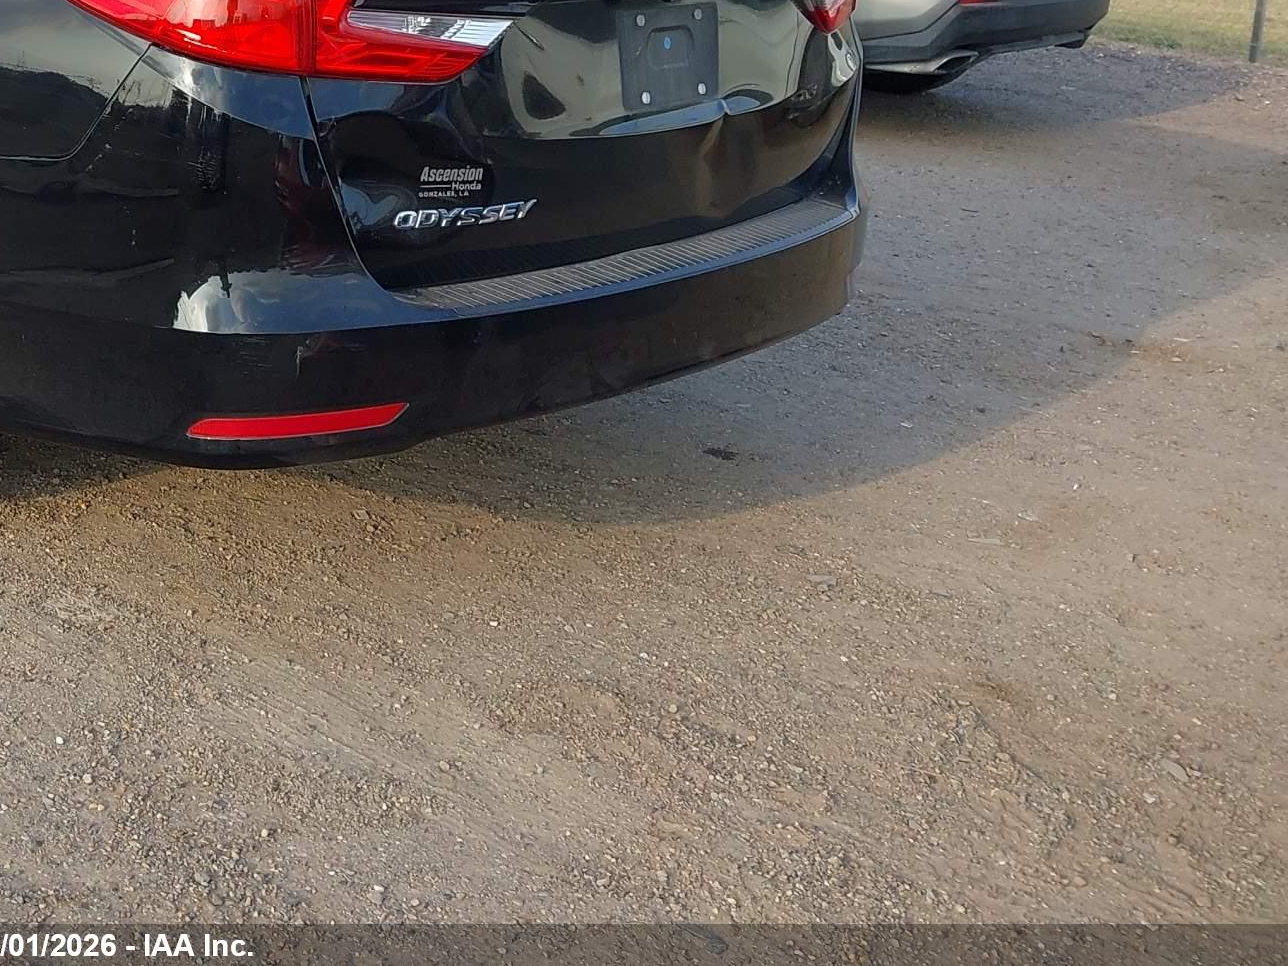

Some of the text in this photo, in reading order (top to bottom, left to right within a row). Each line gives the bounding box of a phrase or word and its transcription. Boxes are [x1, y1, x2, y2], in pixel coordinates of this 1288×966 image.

[420, 165, 483, 182] Ascension
[452, 181, 482, 191] Honda
[394, 199, 537, 229] ODYSSEY
